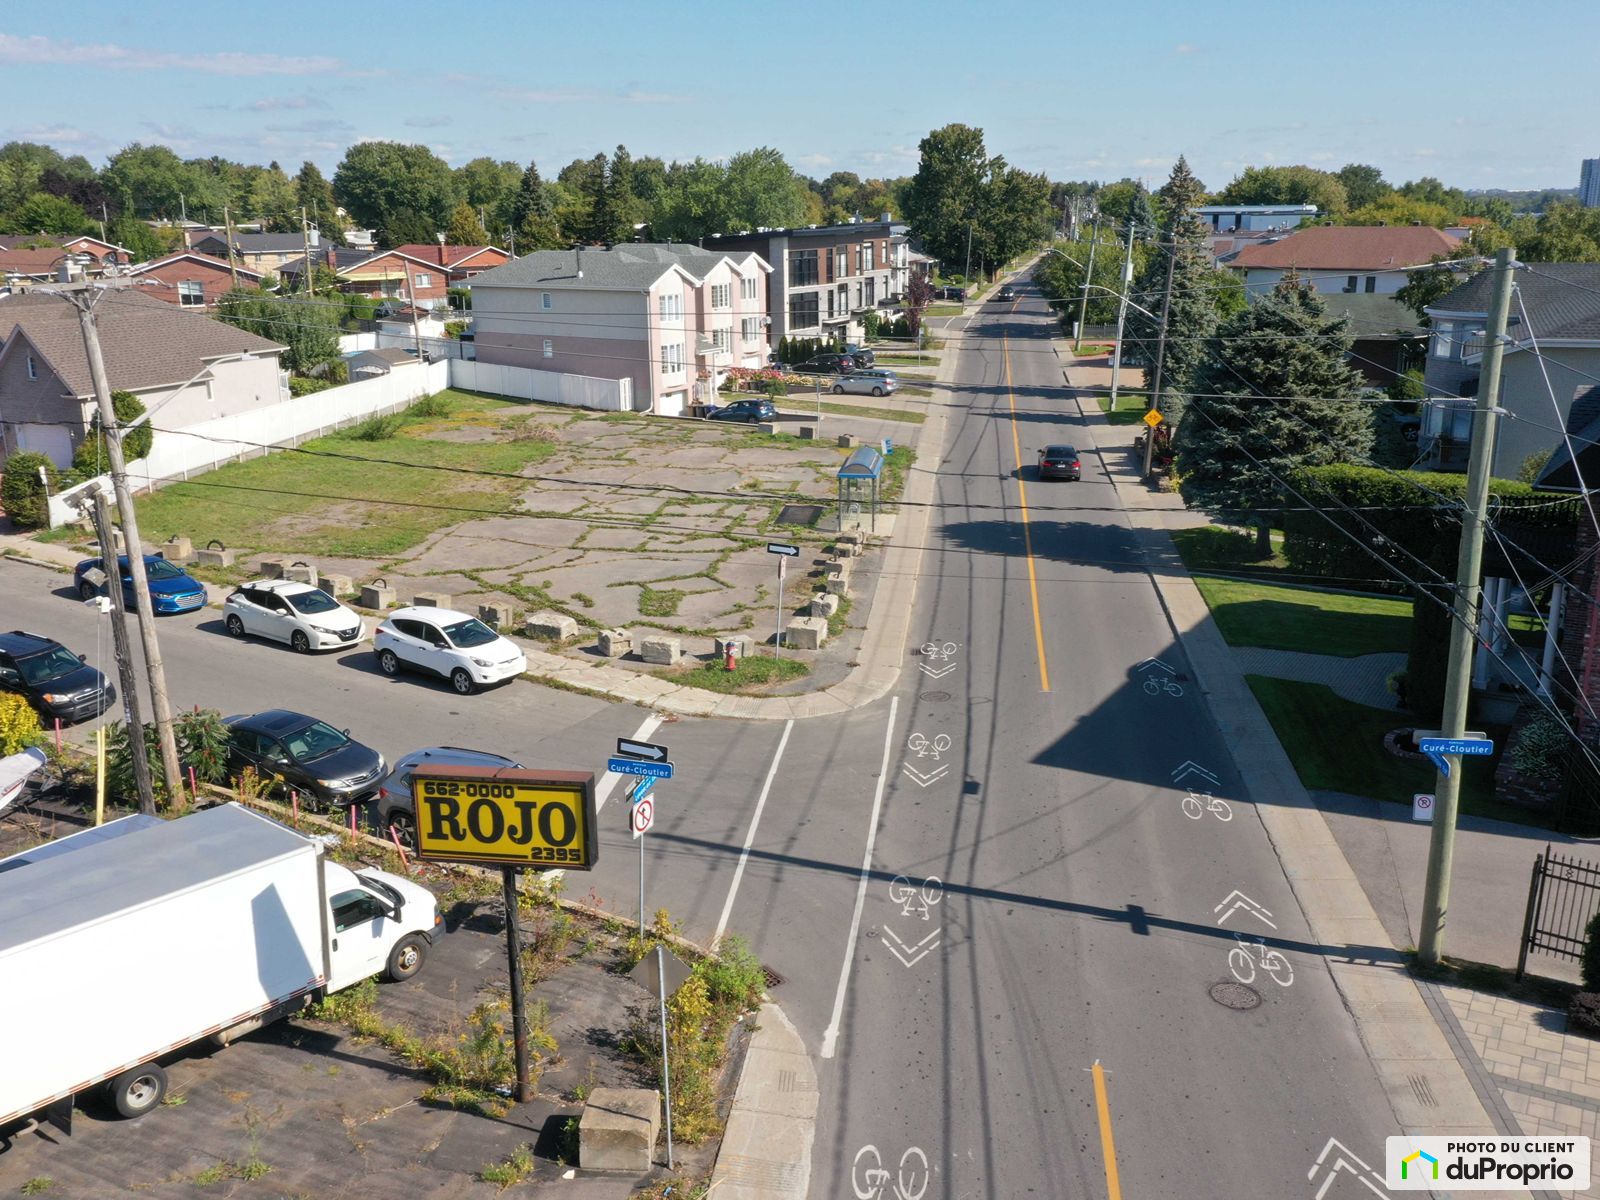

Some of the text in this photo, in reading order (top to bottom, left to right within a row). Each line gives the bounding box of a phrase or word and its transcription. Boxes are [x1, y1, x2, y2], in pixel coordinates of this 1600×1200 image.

[1423, 744, 1488, 753] Curé-Cloutier
[610, 764, 669, 777] Curé-Cloutier
[424, 782, 515, 799] 662-0000
[423, 796, 577, 847] ROJO
[530, 847, 581, 862] 2395
